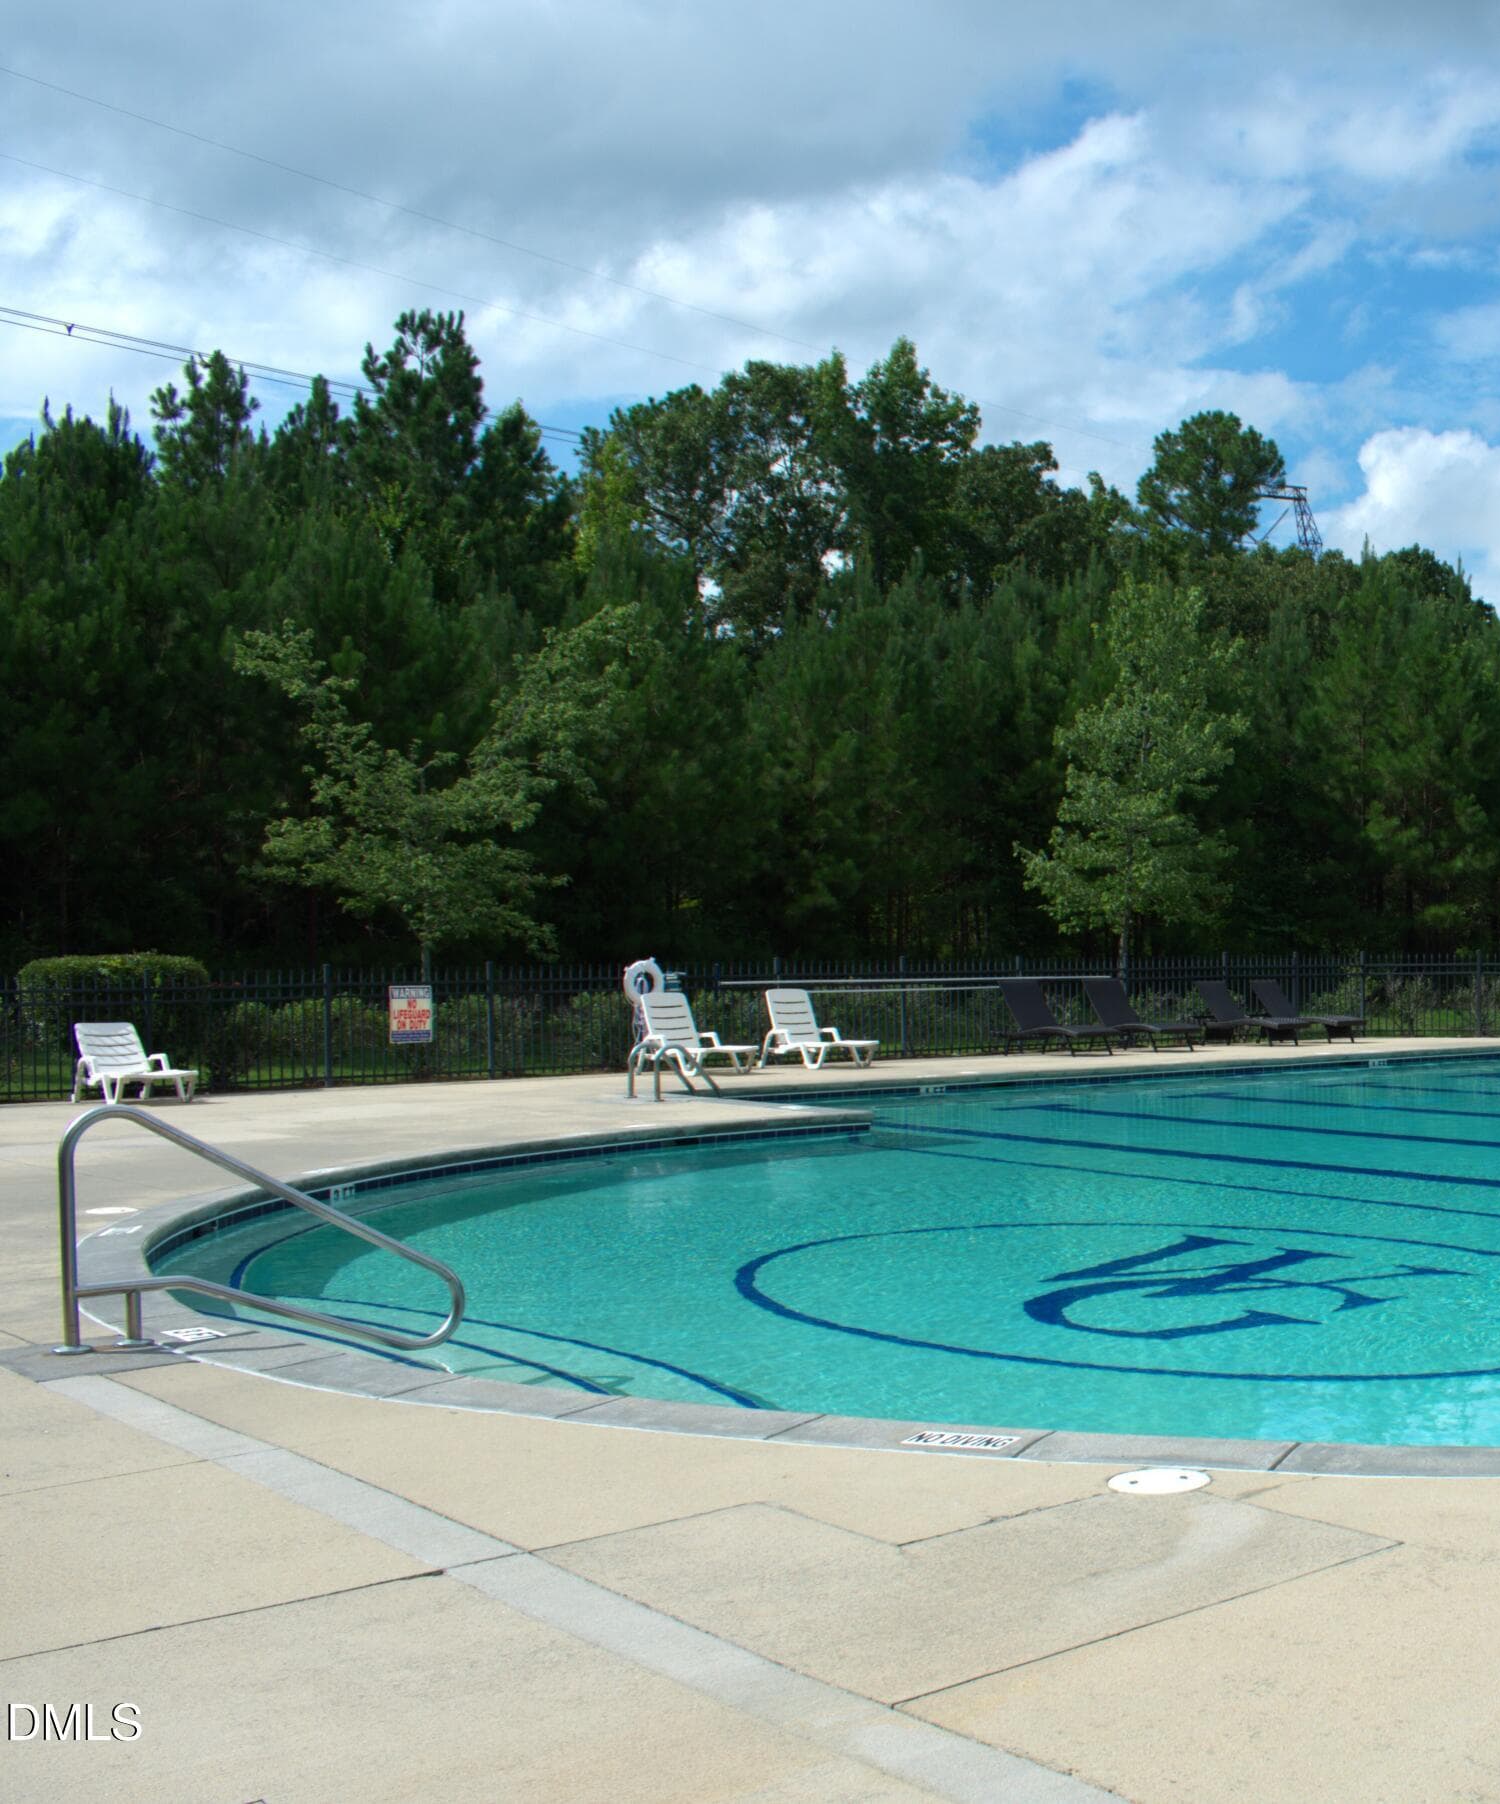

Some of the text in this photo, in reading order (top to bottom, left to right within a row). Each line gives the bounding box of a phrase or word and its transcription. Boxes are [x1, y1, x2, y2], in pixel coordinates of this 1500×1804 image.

[391, 988, 431, 998] WARNING
[407, 999, 417, 1009] NO
[393, 1009, 431, 1020] LIFEGUARD
[397, 1019, 428, 1030] ON DUTY
[906, 1432, 1015, 1448] NO DIVING
